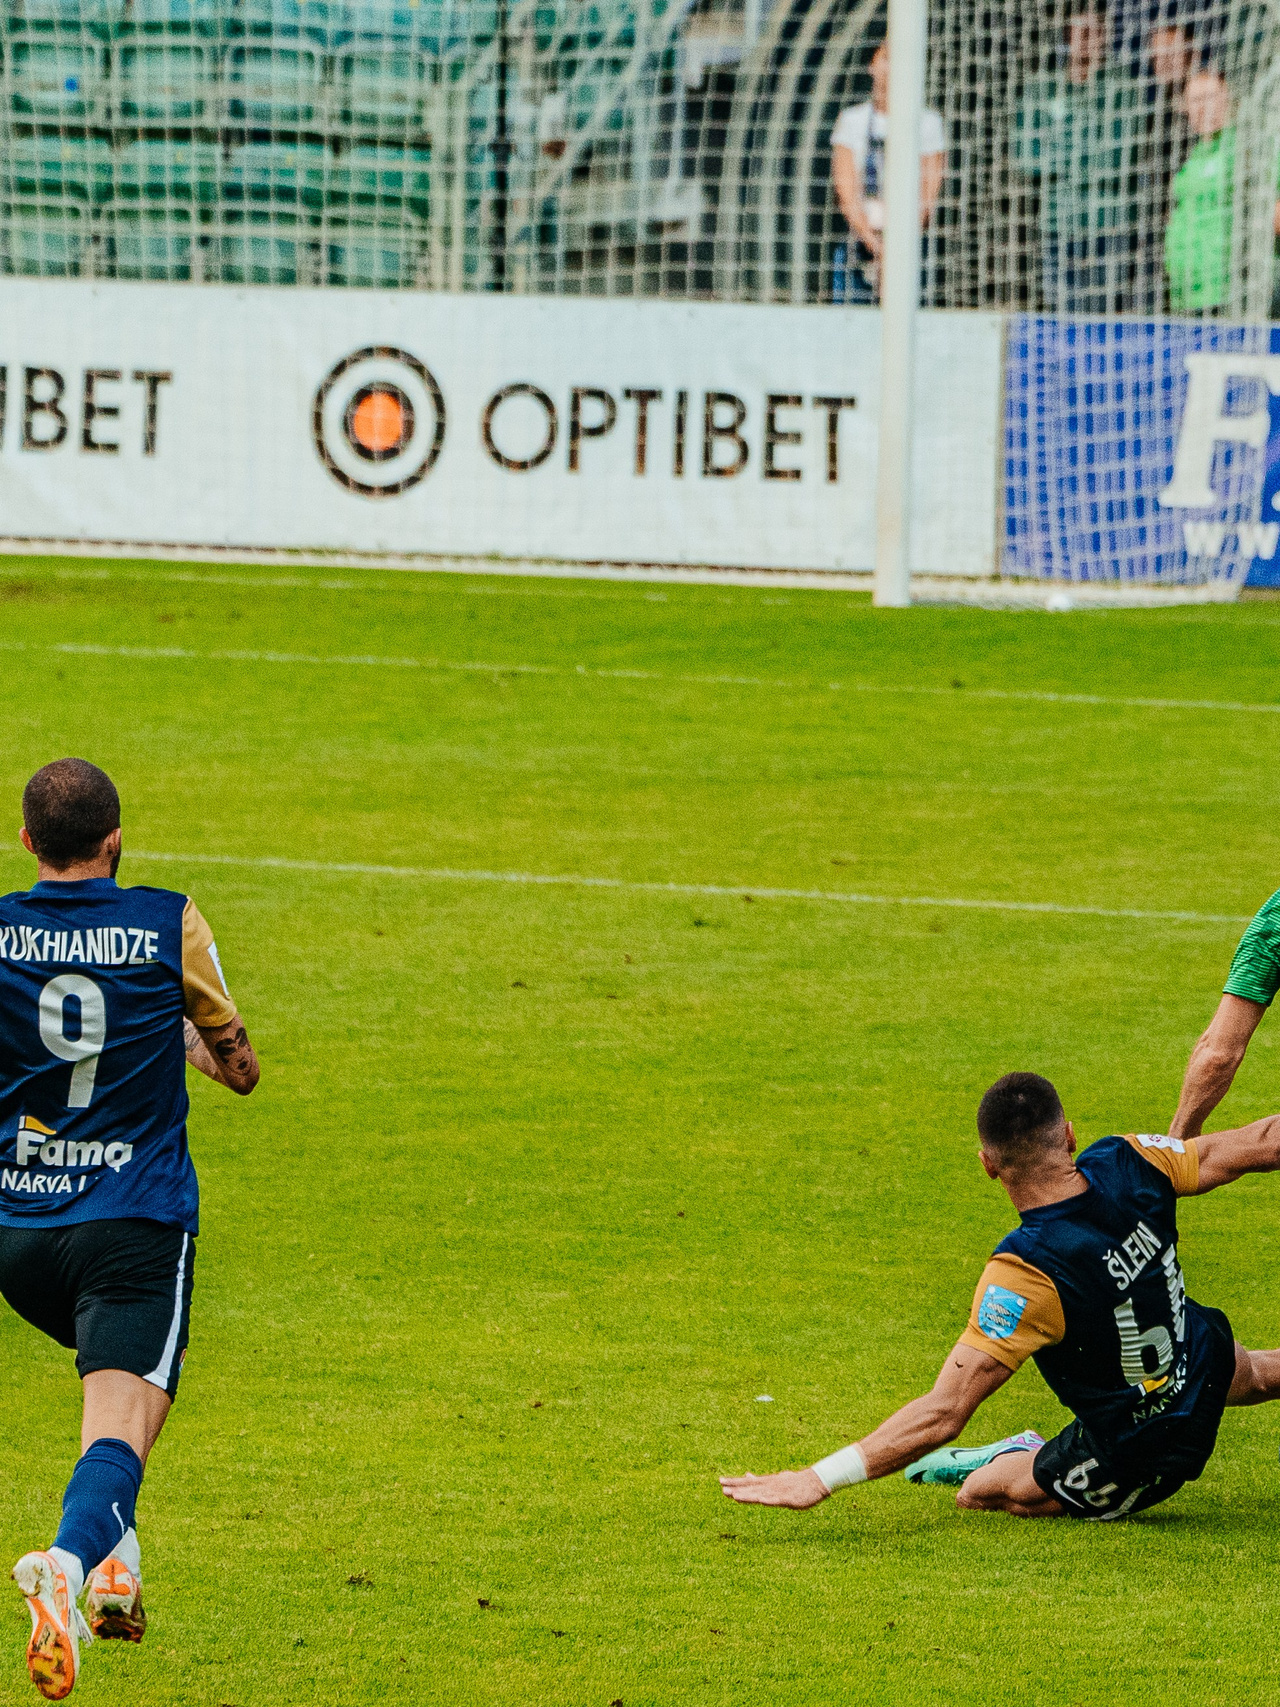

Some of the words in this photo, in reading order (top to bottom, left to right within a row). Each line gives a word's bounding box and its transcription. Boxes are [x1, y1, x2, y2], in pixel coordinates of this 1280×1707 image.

[482, 384, 855, 481] OPTIBET
[38, 974, 107, 1108] 9
[1, 1168, 73, 1194] NARVA
[1102, 1220, 1162, 1291] ŠLEIN
